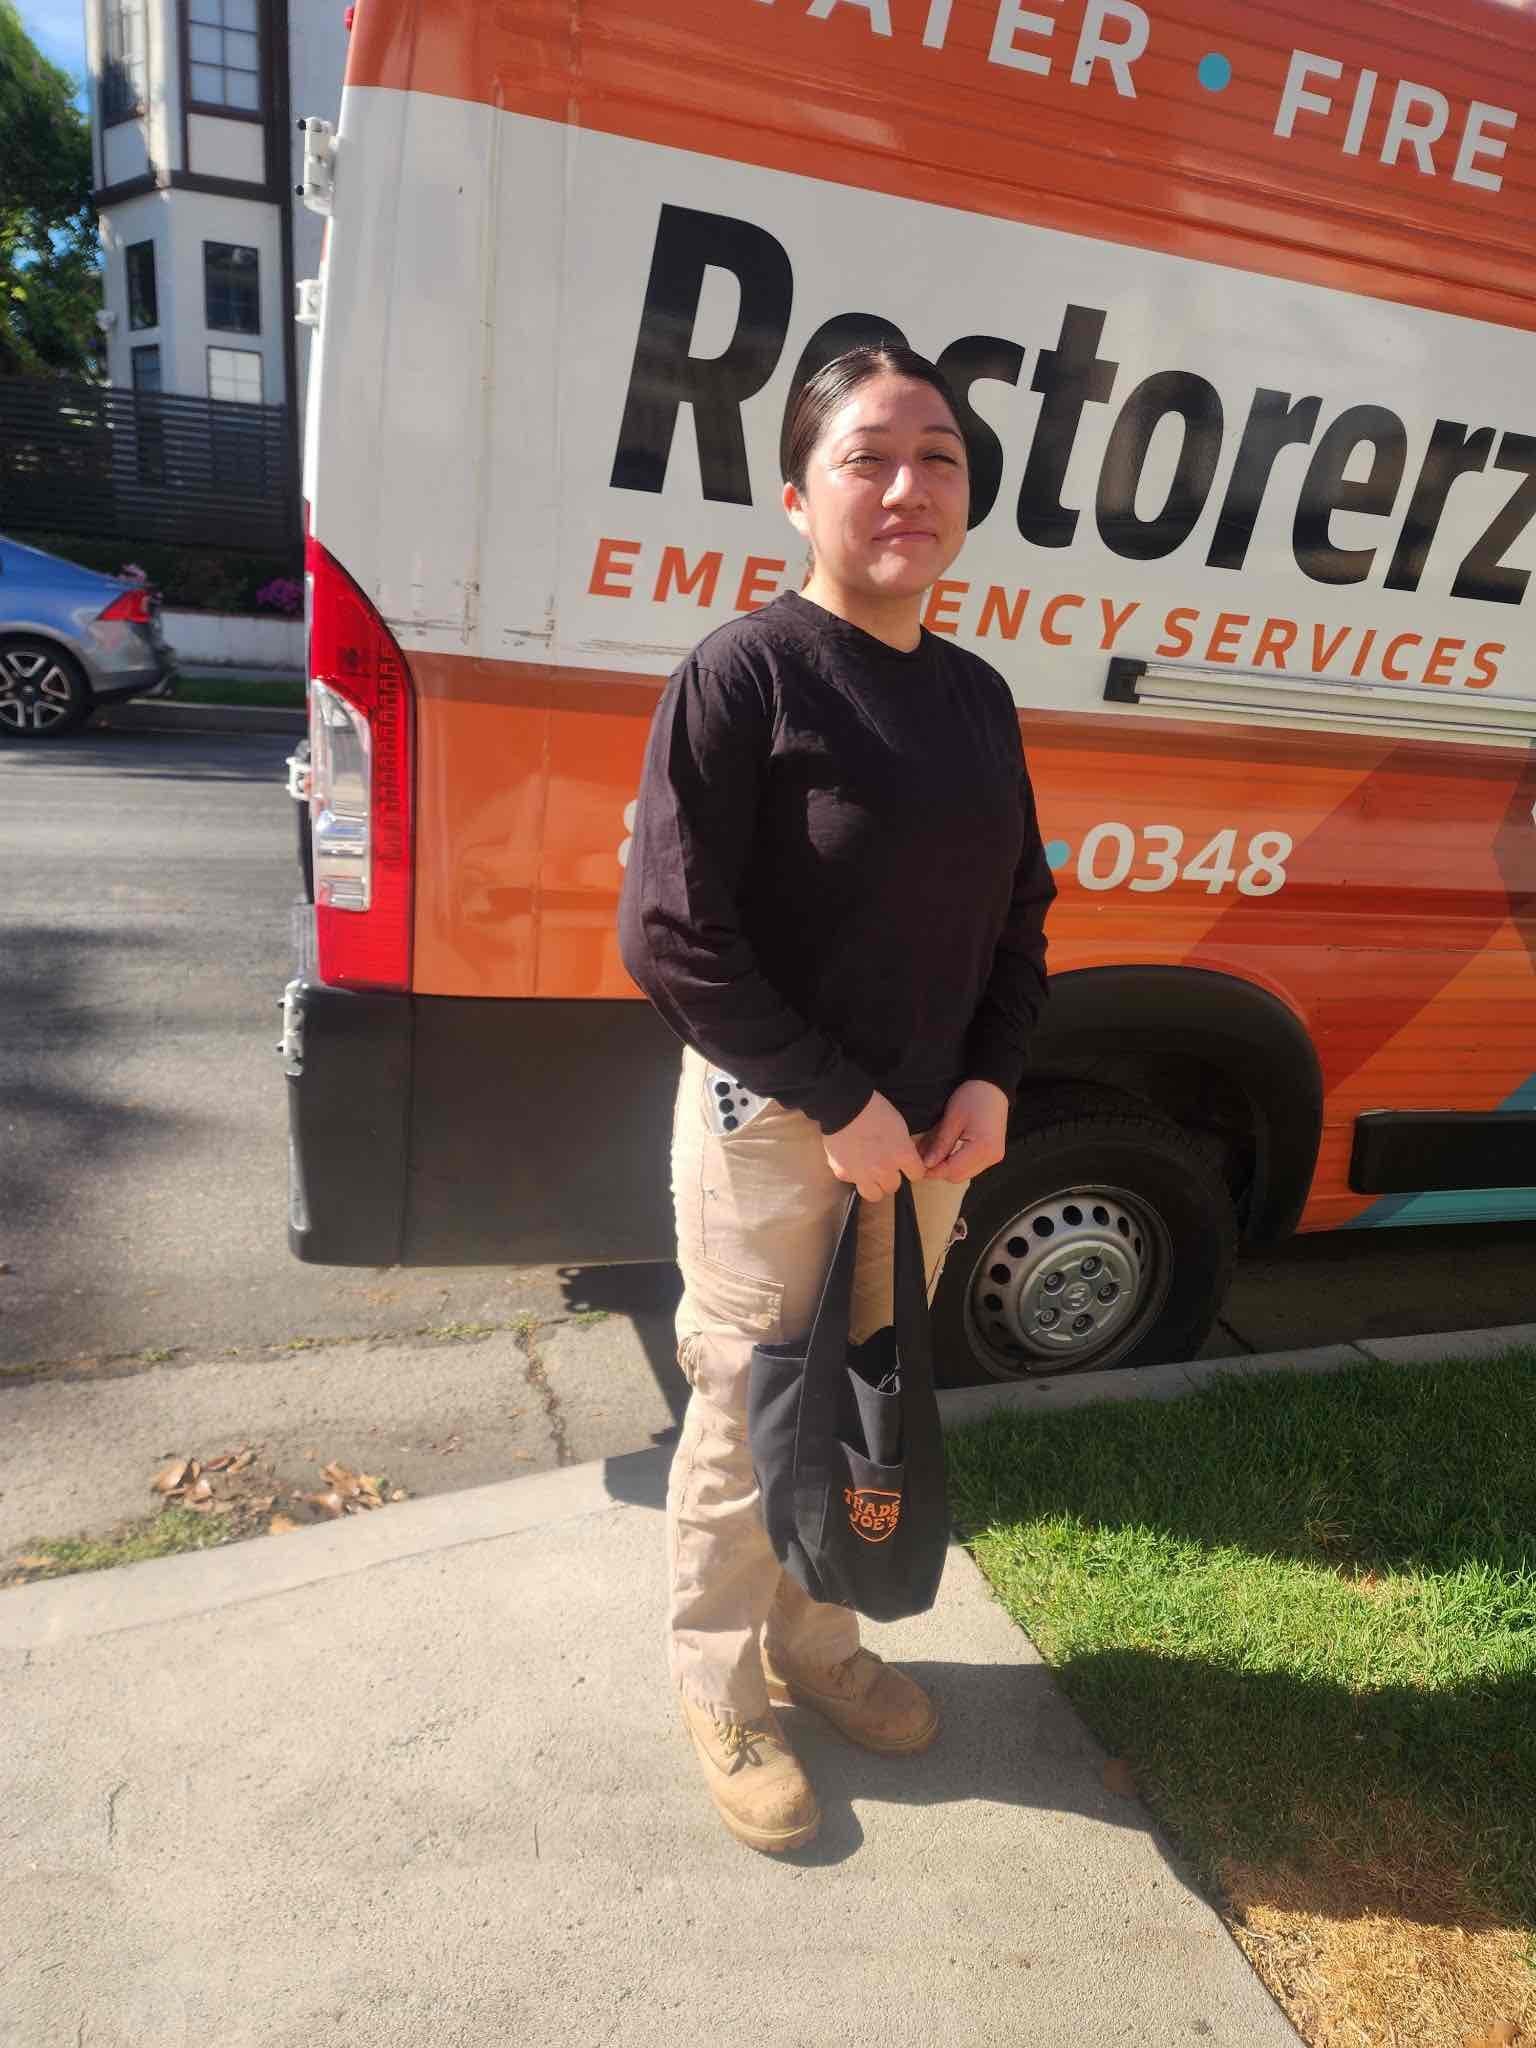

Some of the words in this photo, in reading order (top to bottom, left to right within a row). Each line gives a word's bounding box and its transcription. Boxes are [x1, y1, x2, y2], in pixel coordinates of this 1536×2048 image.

[1273, 49, 1518, 192] FIRE
[587, 538, 1140, 650] EMEENCY
[1155, 607, 1506, 690] SERVICES
[1077, 822, 1293, 896] 0348
